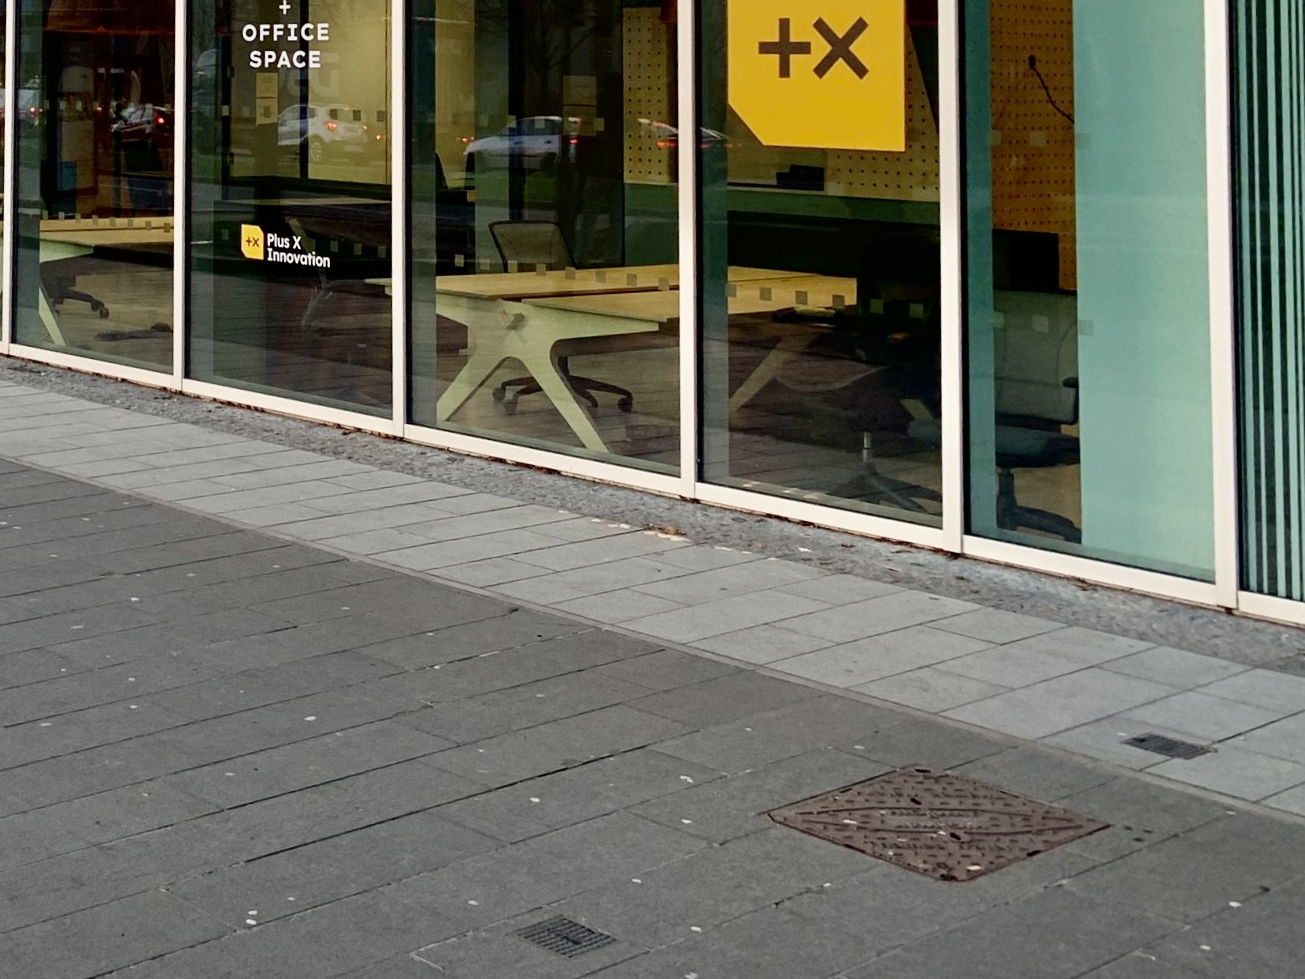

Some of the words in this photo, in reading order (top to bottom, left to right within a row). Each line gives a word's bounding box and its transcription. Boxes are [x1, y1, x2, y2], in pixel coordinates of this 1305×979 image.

[243, 23, 330, 42] OFFICE
[249, 51, 321, 68] SPACE
[266, 233, 290, 249] Plus
[293, 235, 301, 250] X
[266, 247, 331, 268] Innovation
